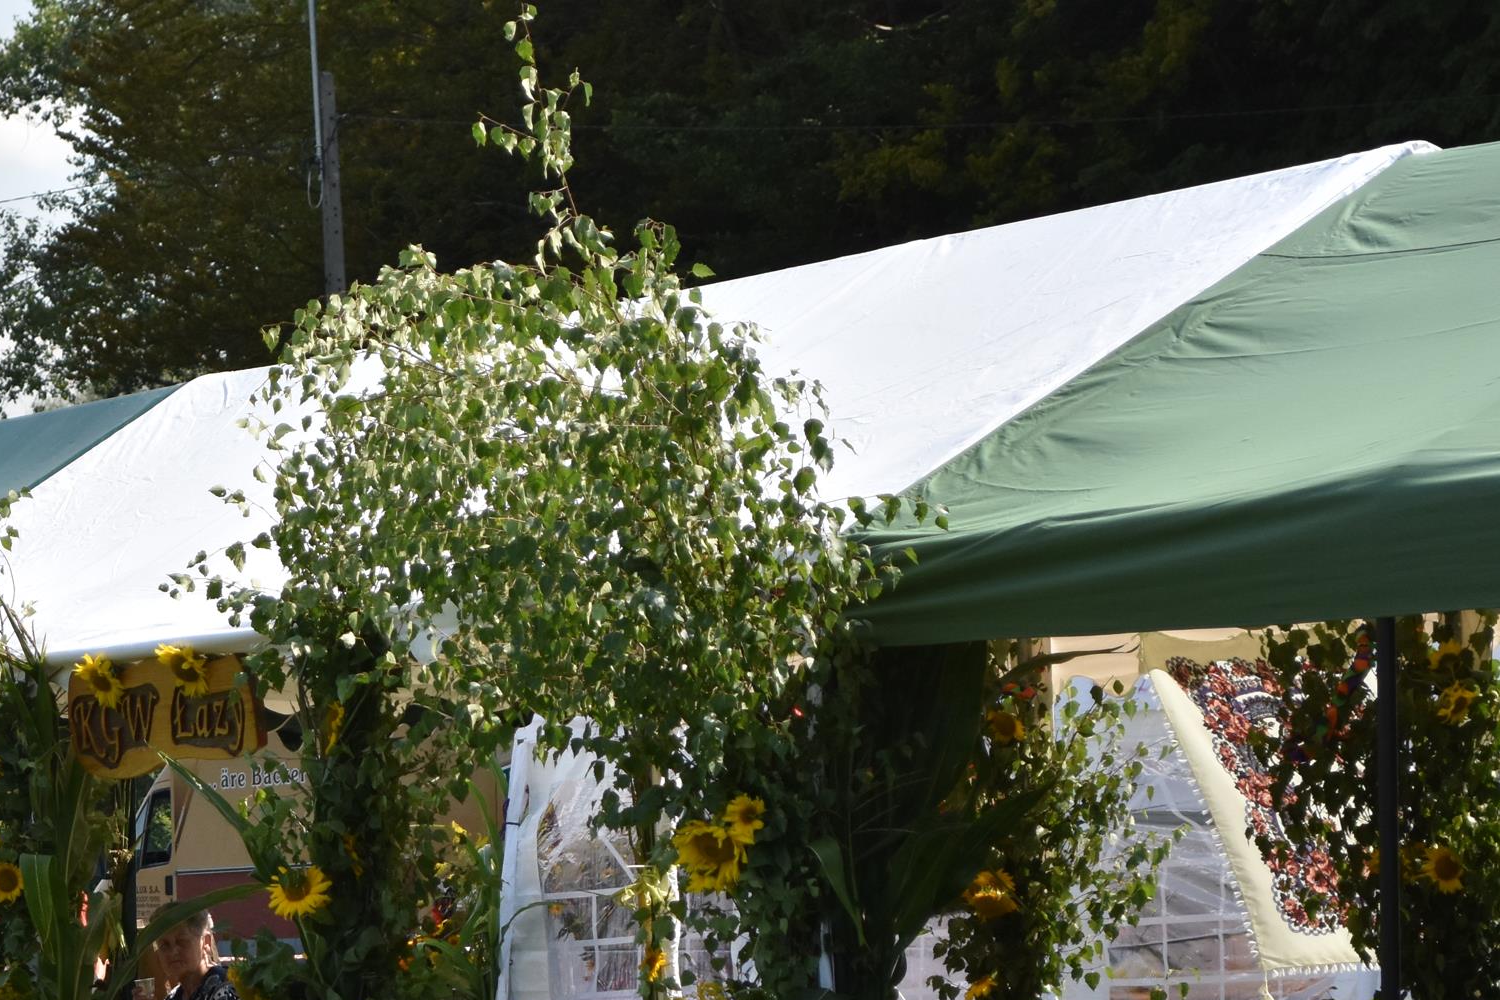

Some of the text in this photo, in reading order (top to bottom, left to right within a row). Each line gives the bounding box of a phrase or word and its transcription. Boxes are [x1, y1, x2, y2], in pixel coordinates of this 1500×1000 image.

[74, 689, 243, 763] KGW Łazy
[221, 768, 246, 789] äre
